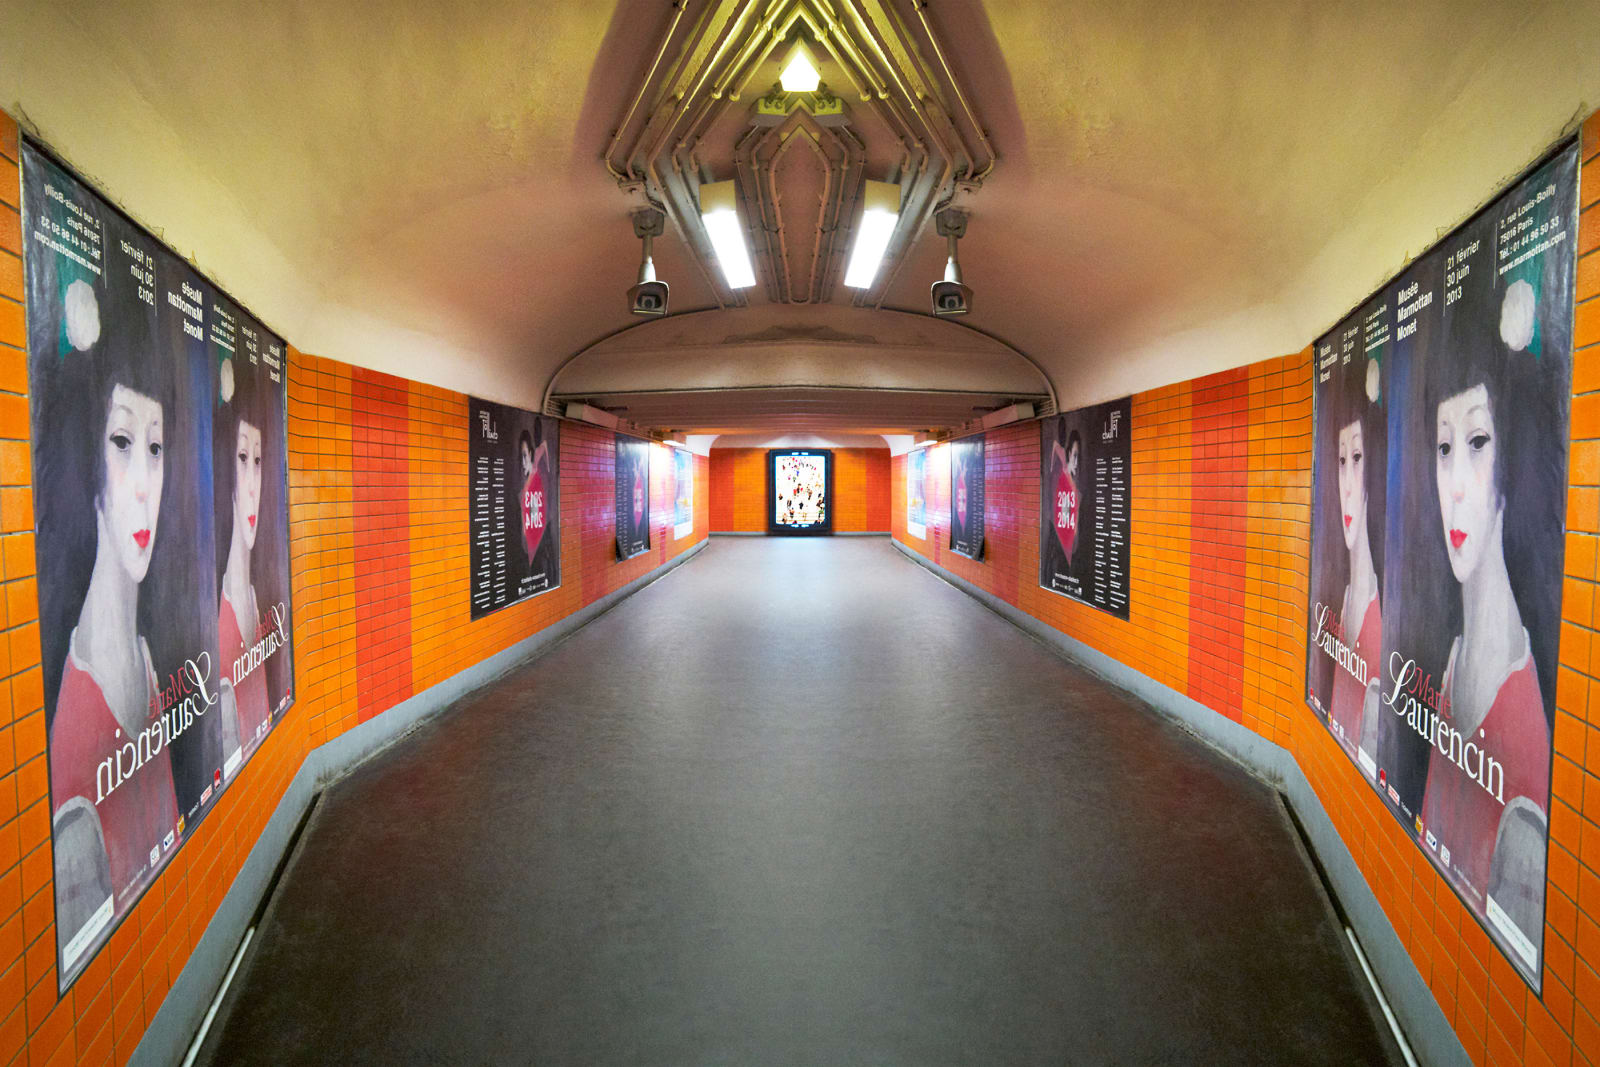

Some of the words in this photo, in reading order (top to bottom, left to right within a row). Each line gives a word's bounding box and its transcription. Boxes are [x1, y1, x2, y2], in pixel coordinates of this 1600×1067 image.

[1500, 227, 1516, 245] 75016
[1517, 217, 1533, 233] Paris
[1507, 212, 1517, 225] rue
[1530, 228, 1539, 242] 96
[1540, 223, 1549, 236] 50
[1550, 216, 1559, 229] 33
[1447, 256, 1455, 271] 21
[1456, 240, 1480, 264] février
[1447, 272, 1455, 287] 30
[1456, 264, 1470, 284] juin
[1398, 282, 1419, 306] Musée
[1446, 286, 1462, 306] 2013
[1397, 291, 1433, 323] Marmottan
[1397, 318, 1417, 342] Monet
[1057, 490, 1075, 508] 2013
[1057, 511, 1075, 530] 2014
[1312, 602, 1368, 687] Laurencin
[1405, 666, 1453, 719] Marie
[1382, 651, 1506, 806] Laurencin
